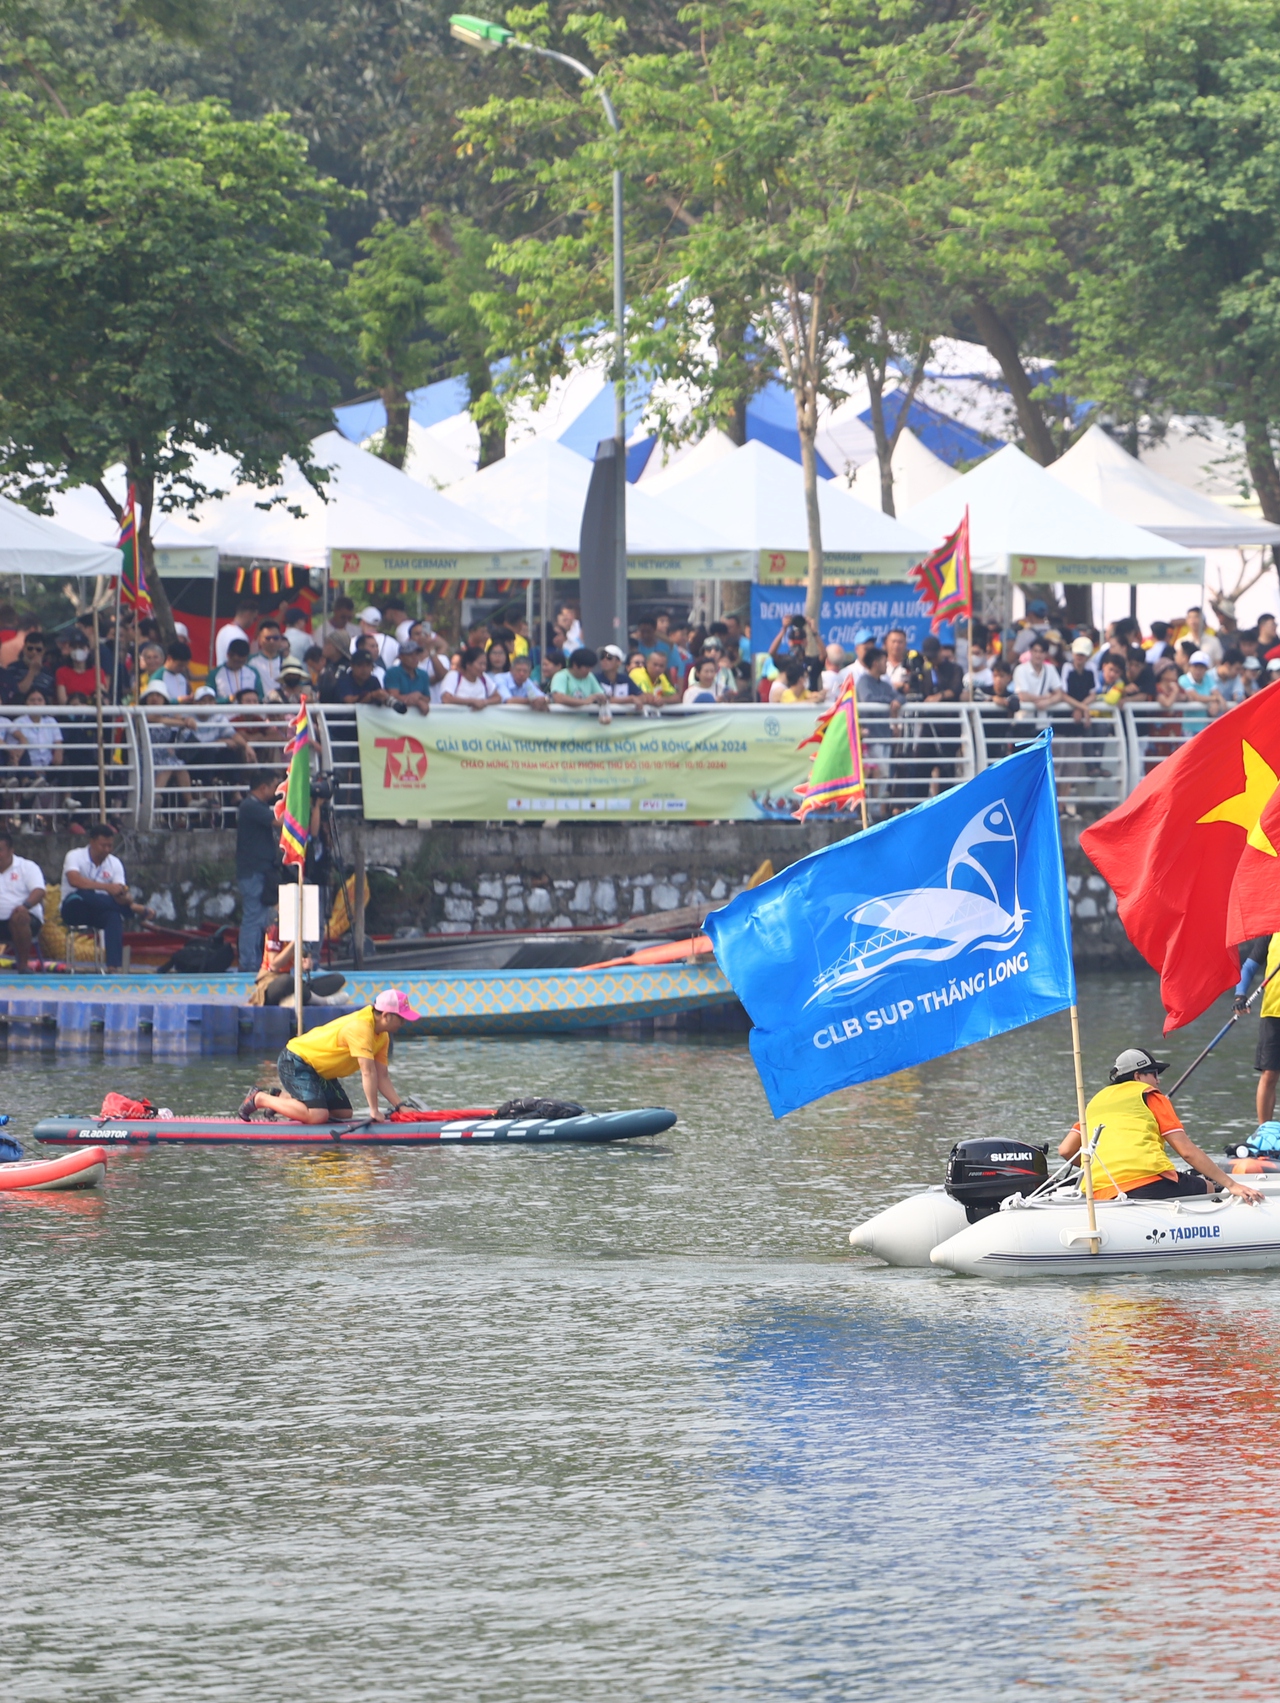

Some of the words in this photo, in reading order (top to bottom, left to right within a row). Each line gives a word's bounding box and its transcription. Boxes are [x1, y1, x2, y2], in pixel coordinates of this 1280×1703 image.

[383, 558, 409, 569] TEAM
[411, 558, 458, 569] GERMANY
[638, 560, 681, 569] NETWORK
[847, 567, 879, 576] ALUMNI
[1056, 564, 1088, 575] UNITED
[1090, 564, 1129, 576] NATIONS
[821, 601, 830, 619] &
[834, 601, 887, 619] SWEDEN
[436, 735, 459, 752] GIẢI
[462, 737, 483, 752] BƠI
[514, 736, 557, 753] THUYỀN
[560, 737, 592, 753] RỒNG
[595, 738, 611, 753] HÀ
[614, 737, 636, 753] NỘI
[640, 736, 658, 753] MỞ
[661, 737, 692, 753] RỘNG
[694, 738, 718, 752] NĂM
[721, 740, 747, 752] 2024
[461, 758, 485, 770] CHÀO
[512, 760, 520, 769] 70
[813, 1017, 863, 1049] CLB
[865, 999, 915, 1031] SUP
[917, 972, 985, 1014] THĂNG
[988, 951, 1029, 987] LONG
[990, 1152, 1033, 1162] SUZUKI
[1169, 1225, 1220, 1243] TADPOLE
